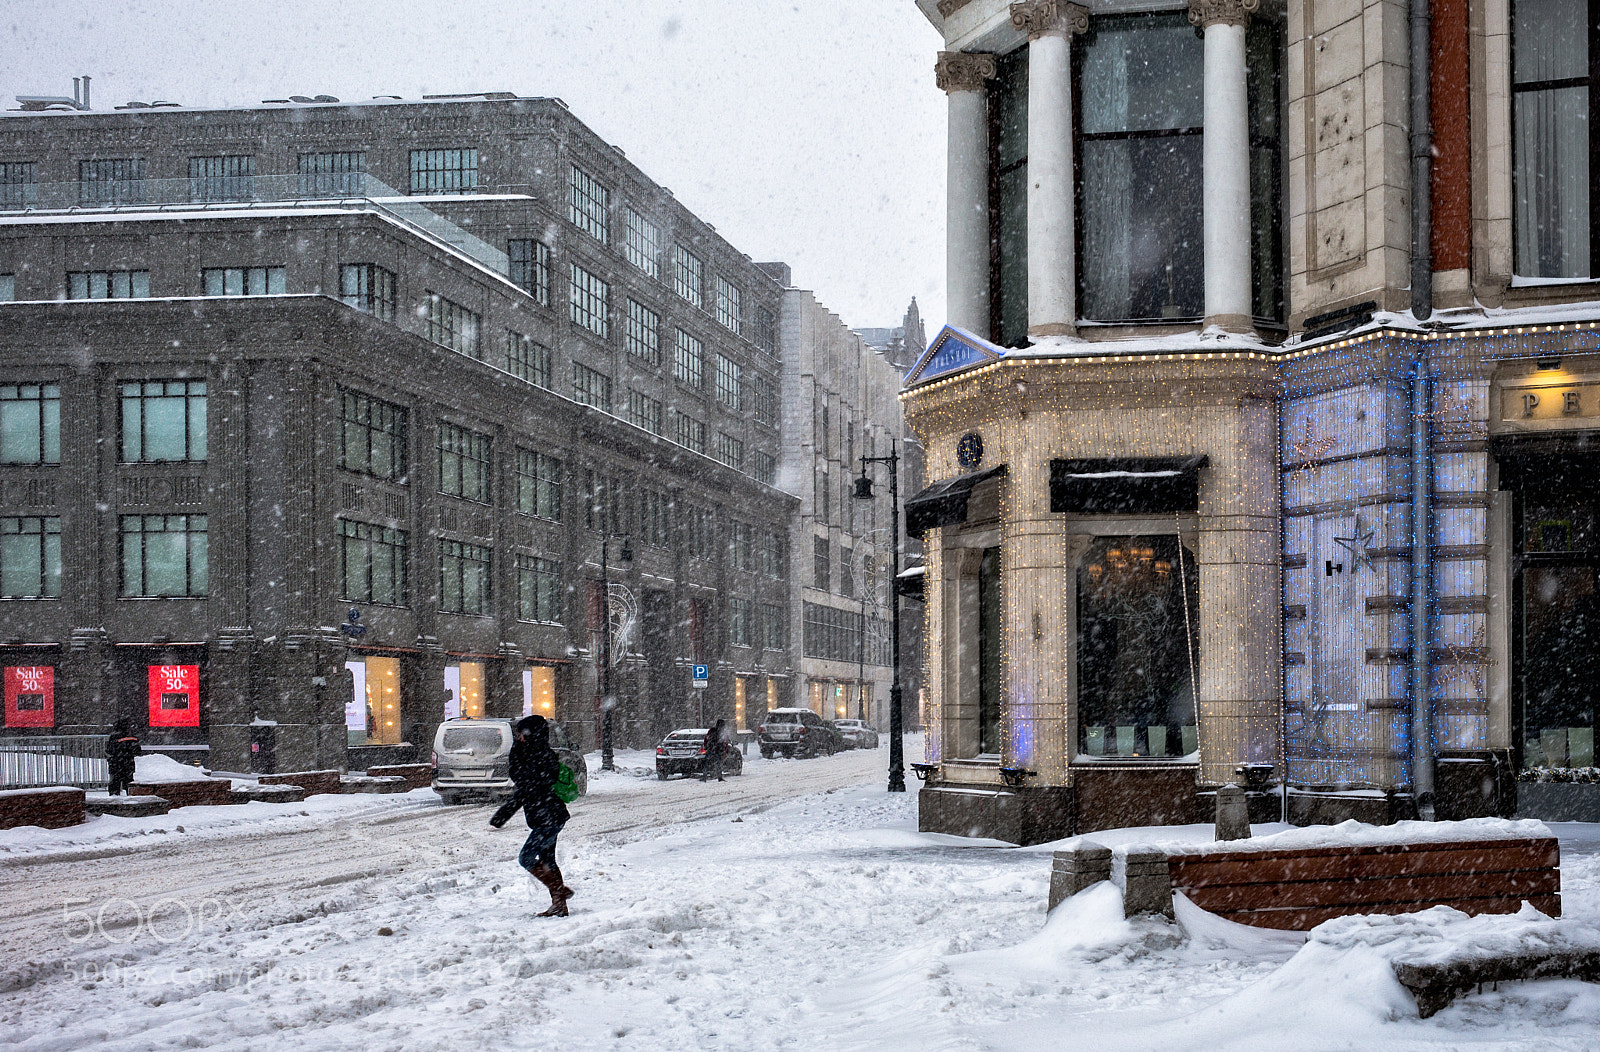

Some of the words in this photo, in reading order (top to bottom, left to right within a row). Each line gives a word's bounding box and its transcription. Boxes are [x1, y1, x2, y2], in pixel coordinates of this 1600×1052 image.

[1521, 391, 1600, 418] PE
[16, 666, 44, 679] Sale
[160, 665, 188, 678] Sale
[696, 666, 705, 678] P
